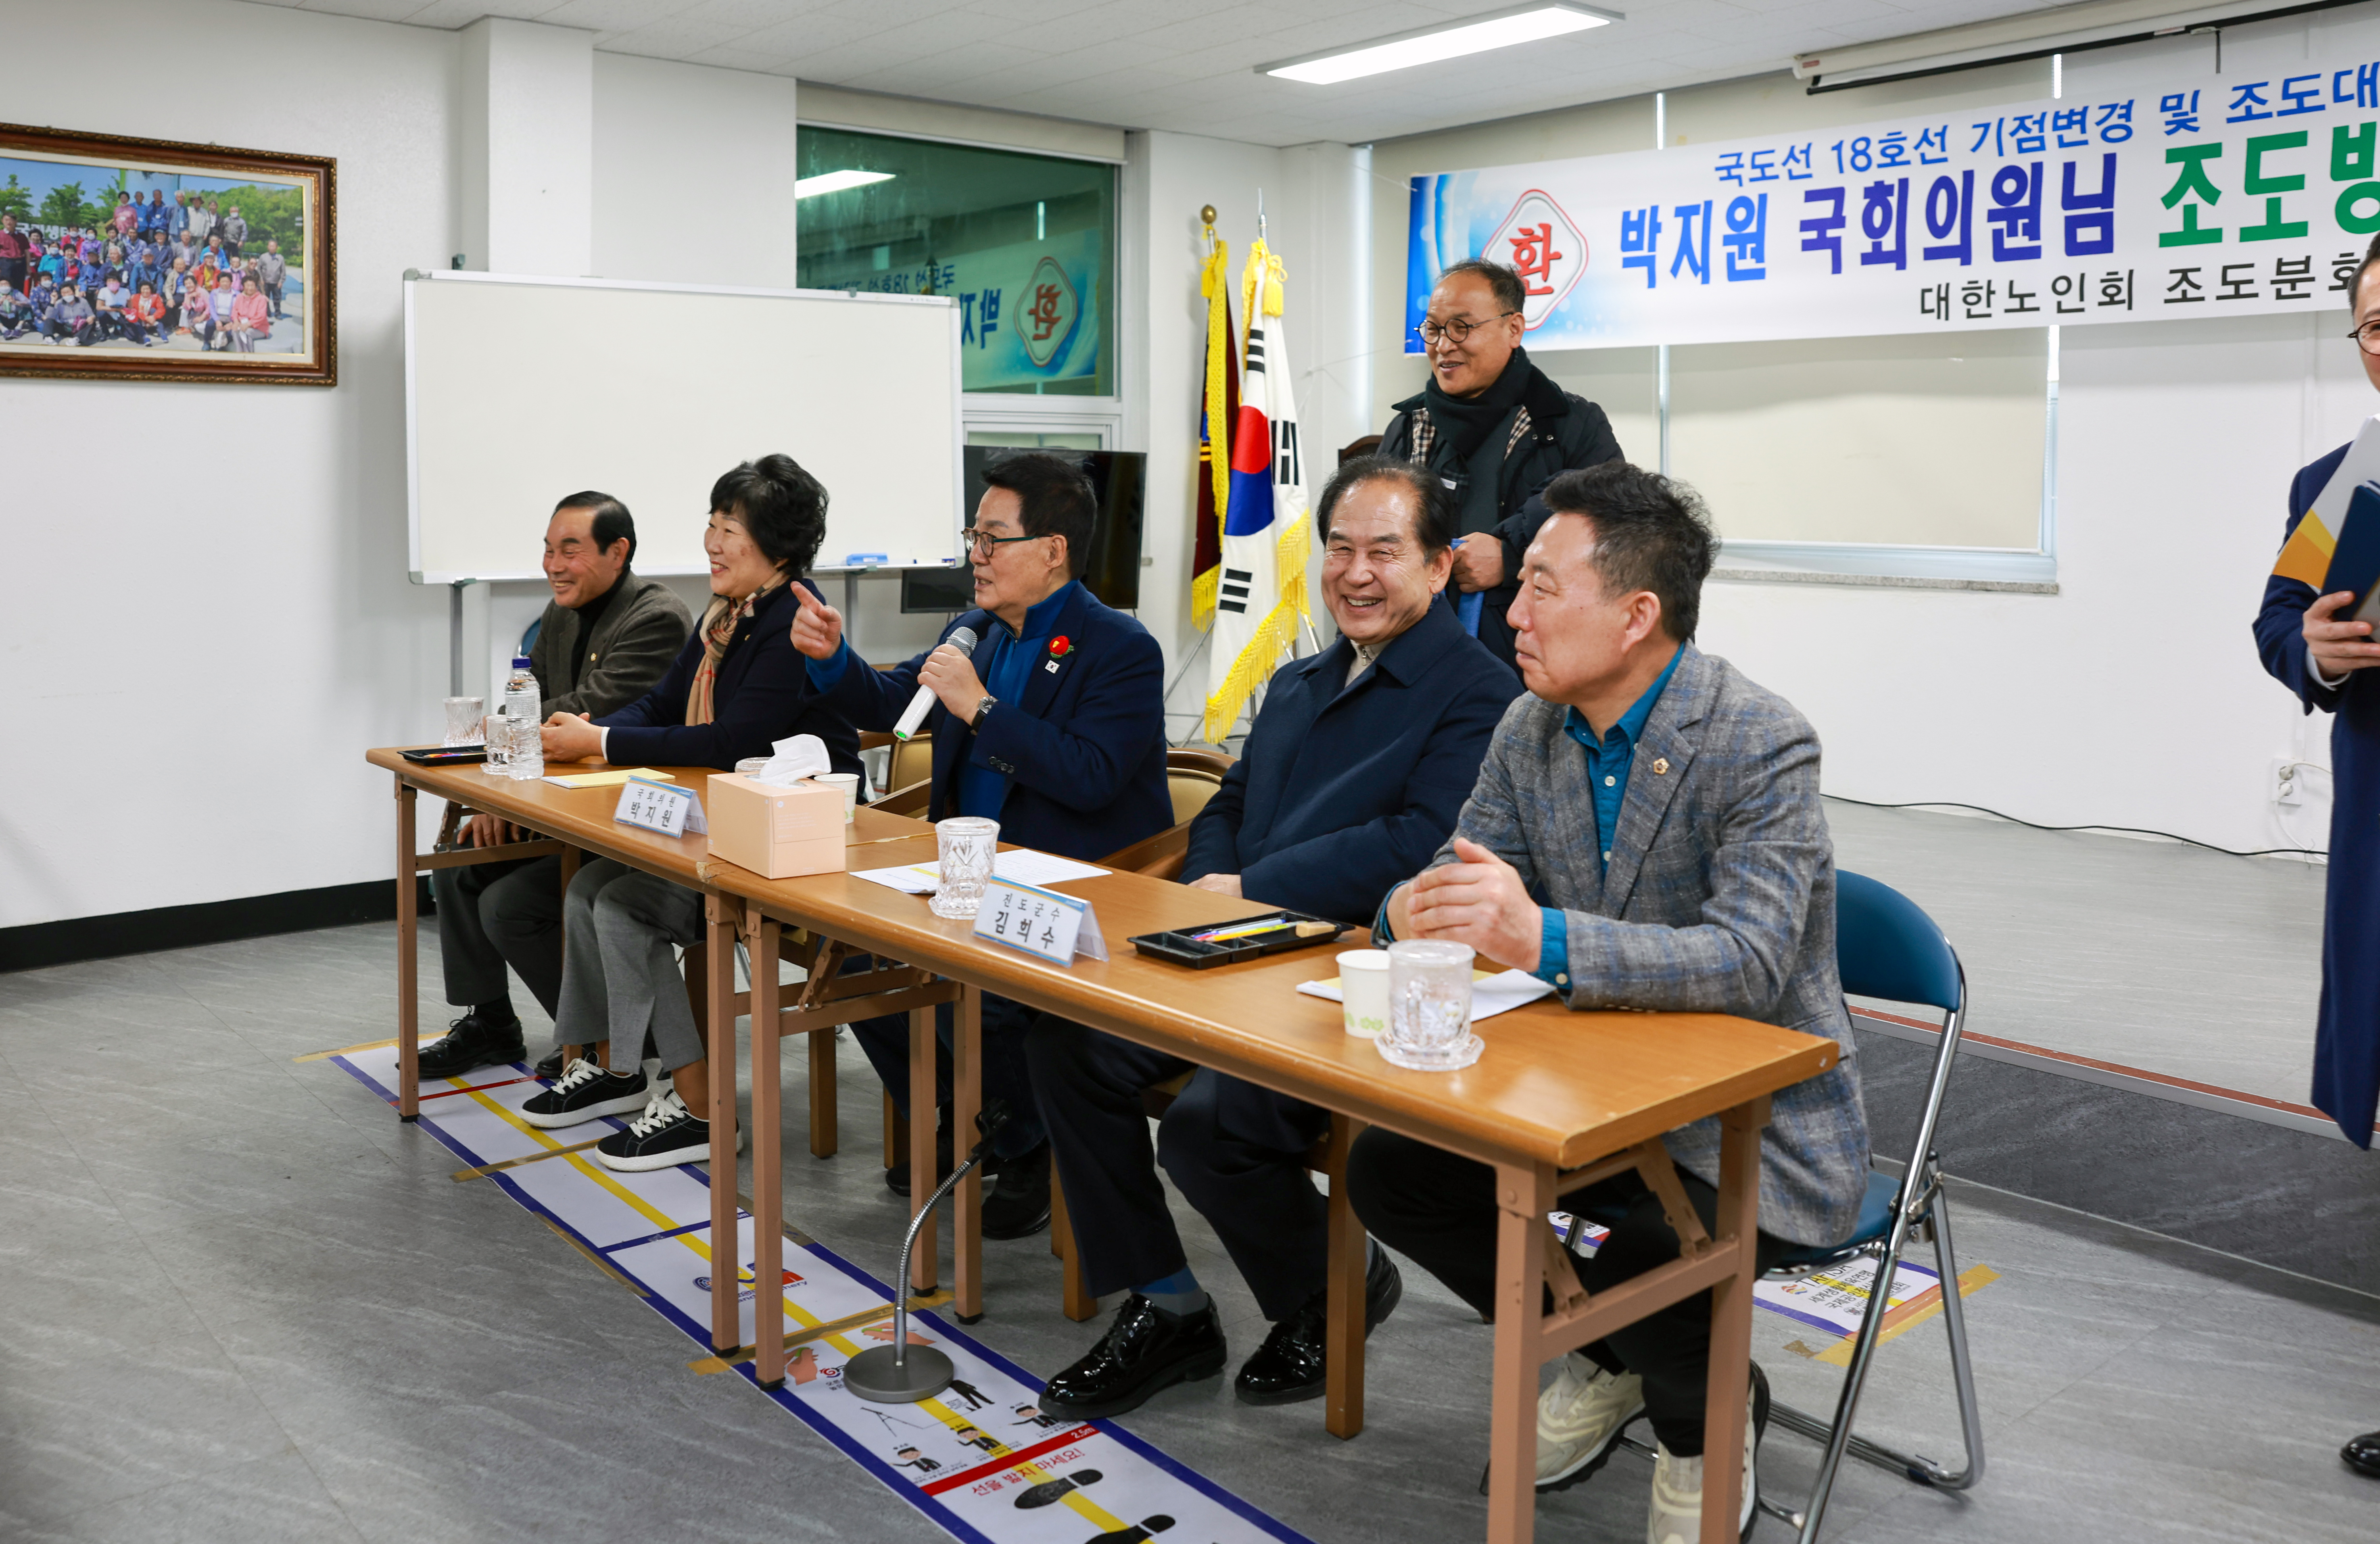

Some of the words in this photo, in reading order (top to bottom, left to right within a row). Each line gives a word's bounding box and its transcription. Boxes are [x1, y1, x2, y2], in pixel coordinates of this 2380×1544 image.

[1715, 142, 1813, 187] 국도선
[1831, 125, 1948, 174] 18호선
[1970, 99, 2135, 157] 기점변경
[2160, 89, 2201, 136] 및
[2226, 61, 2380, 124] 조도대
[1620, 192, 1768, 289] 박지원
[1799, 152, 2117, 275] 국회의원님
[1509, 223, 1562, 296] 환
[1921, 269, 2134, 321] 대한노인회
[1071, 1426, 1096, 1440] 2.5m
[972, 1479, 1004, 1496] 선을
[1002, 1465, 1037, 1484] 밟지
[1034, 1447, 1085, 1471] 마세요!
